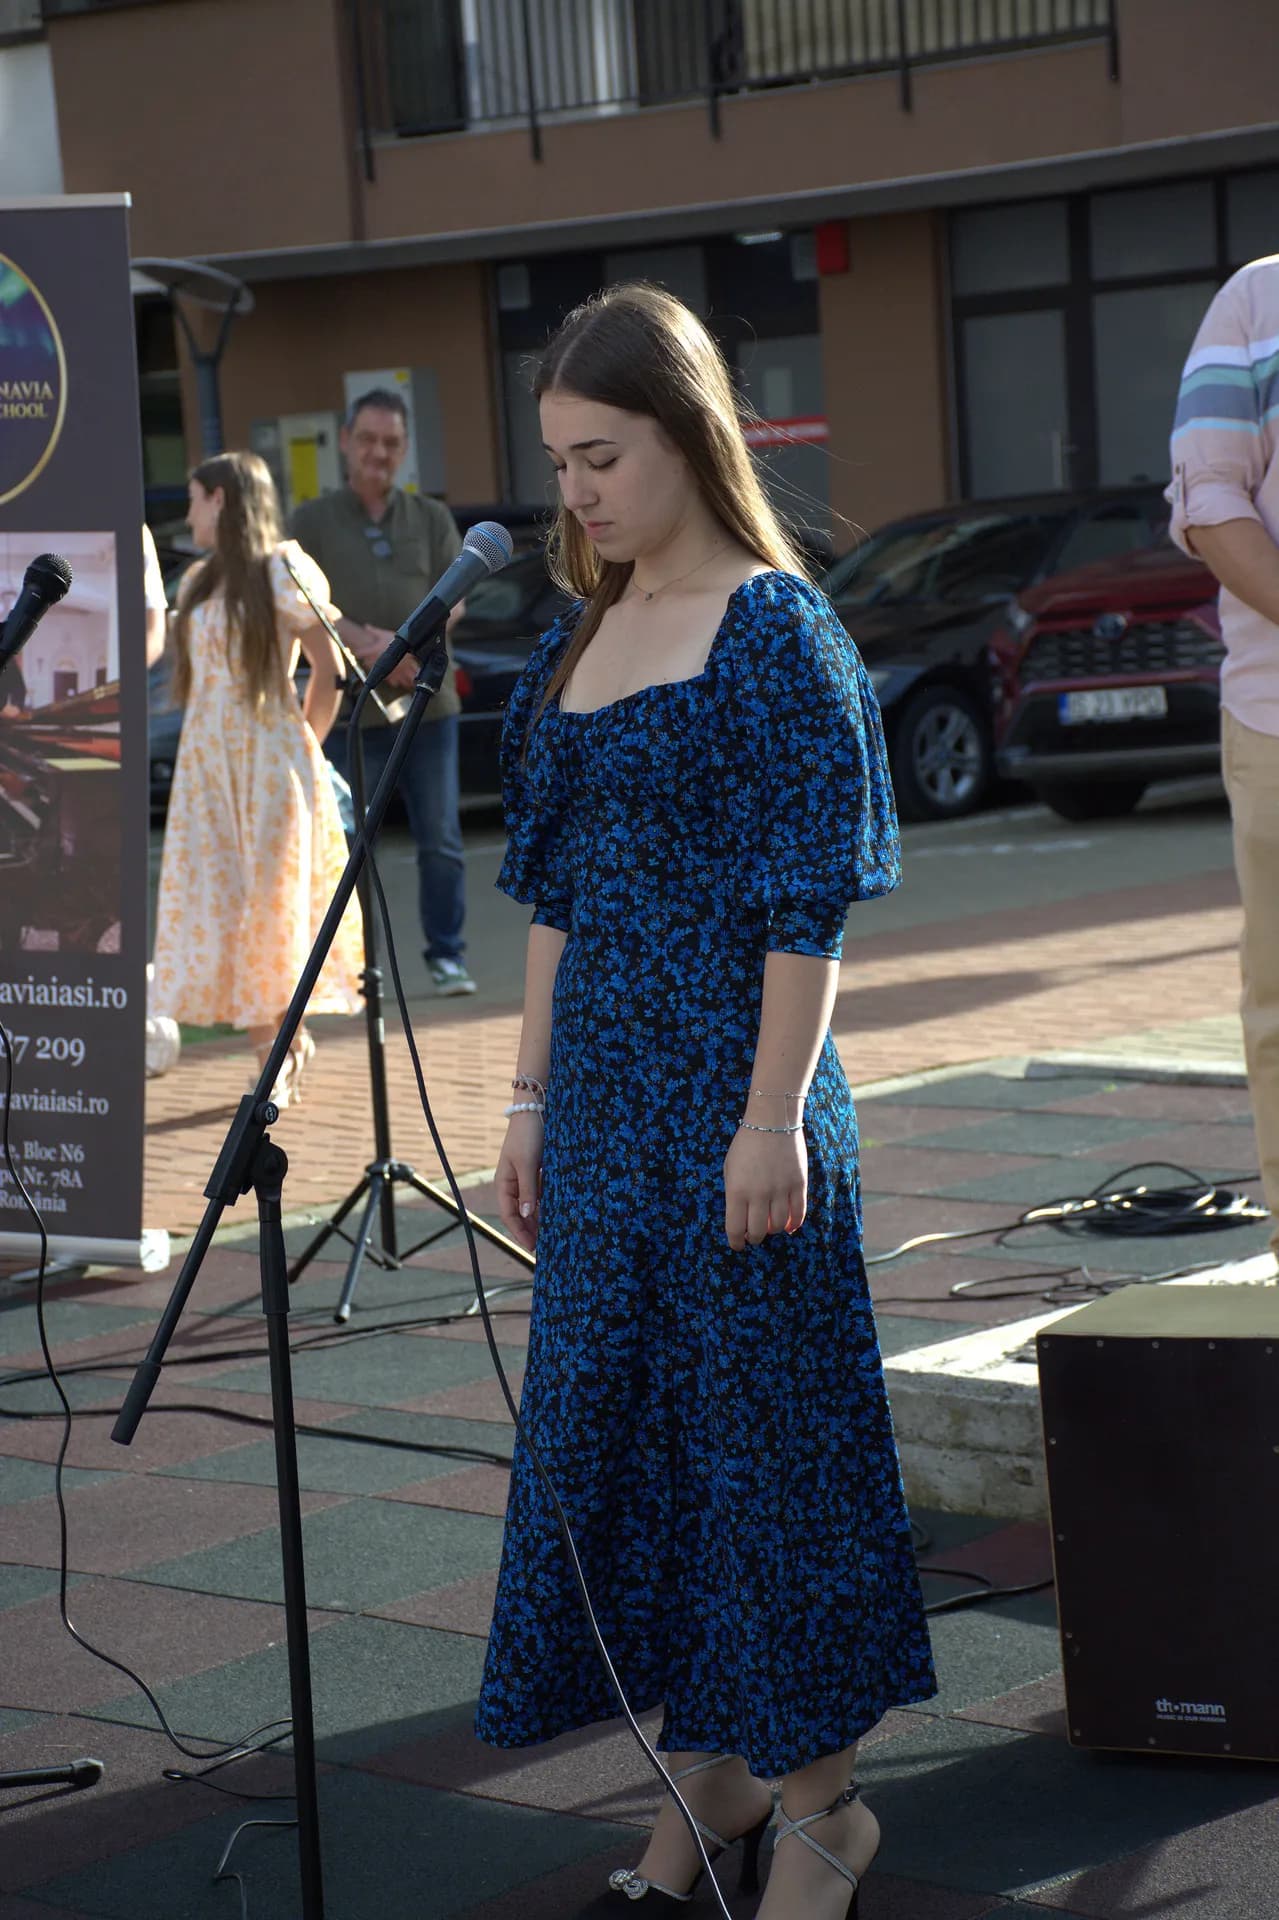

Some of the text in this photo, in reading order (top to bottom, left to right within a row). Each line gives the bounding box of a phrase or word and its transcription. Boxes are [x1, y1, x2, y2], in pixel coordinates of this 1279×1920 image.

[0, 403, 49, 418] HOOL
[0, 975, 128, 1009] aviaiasi.ro
[35, 1036, 86, 1067] 209
[23, 1140, 57, 1161] Bloc
[59, 1143, 85, 1163] N6
[23, 1165, 48, 1185] Nr.
[50, 1168, 83, 1191] 78A
